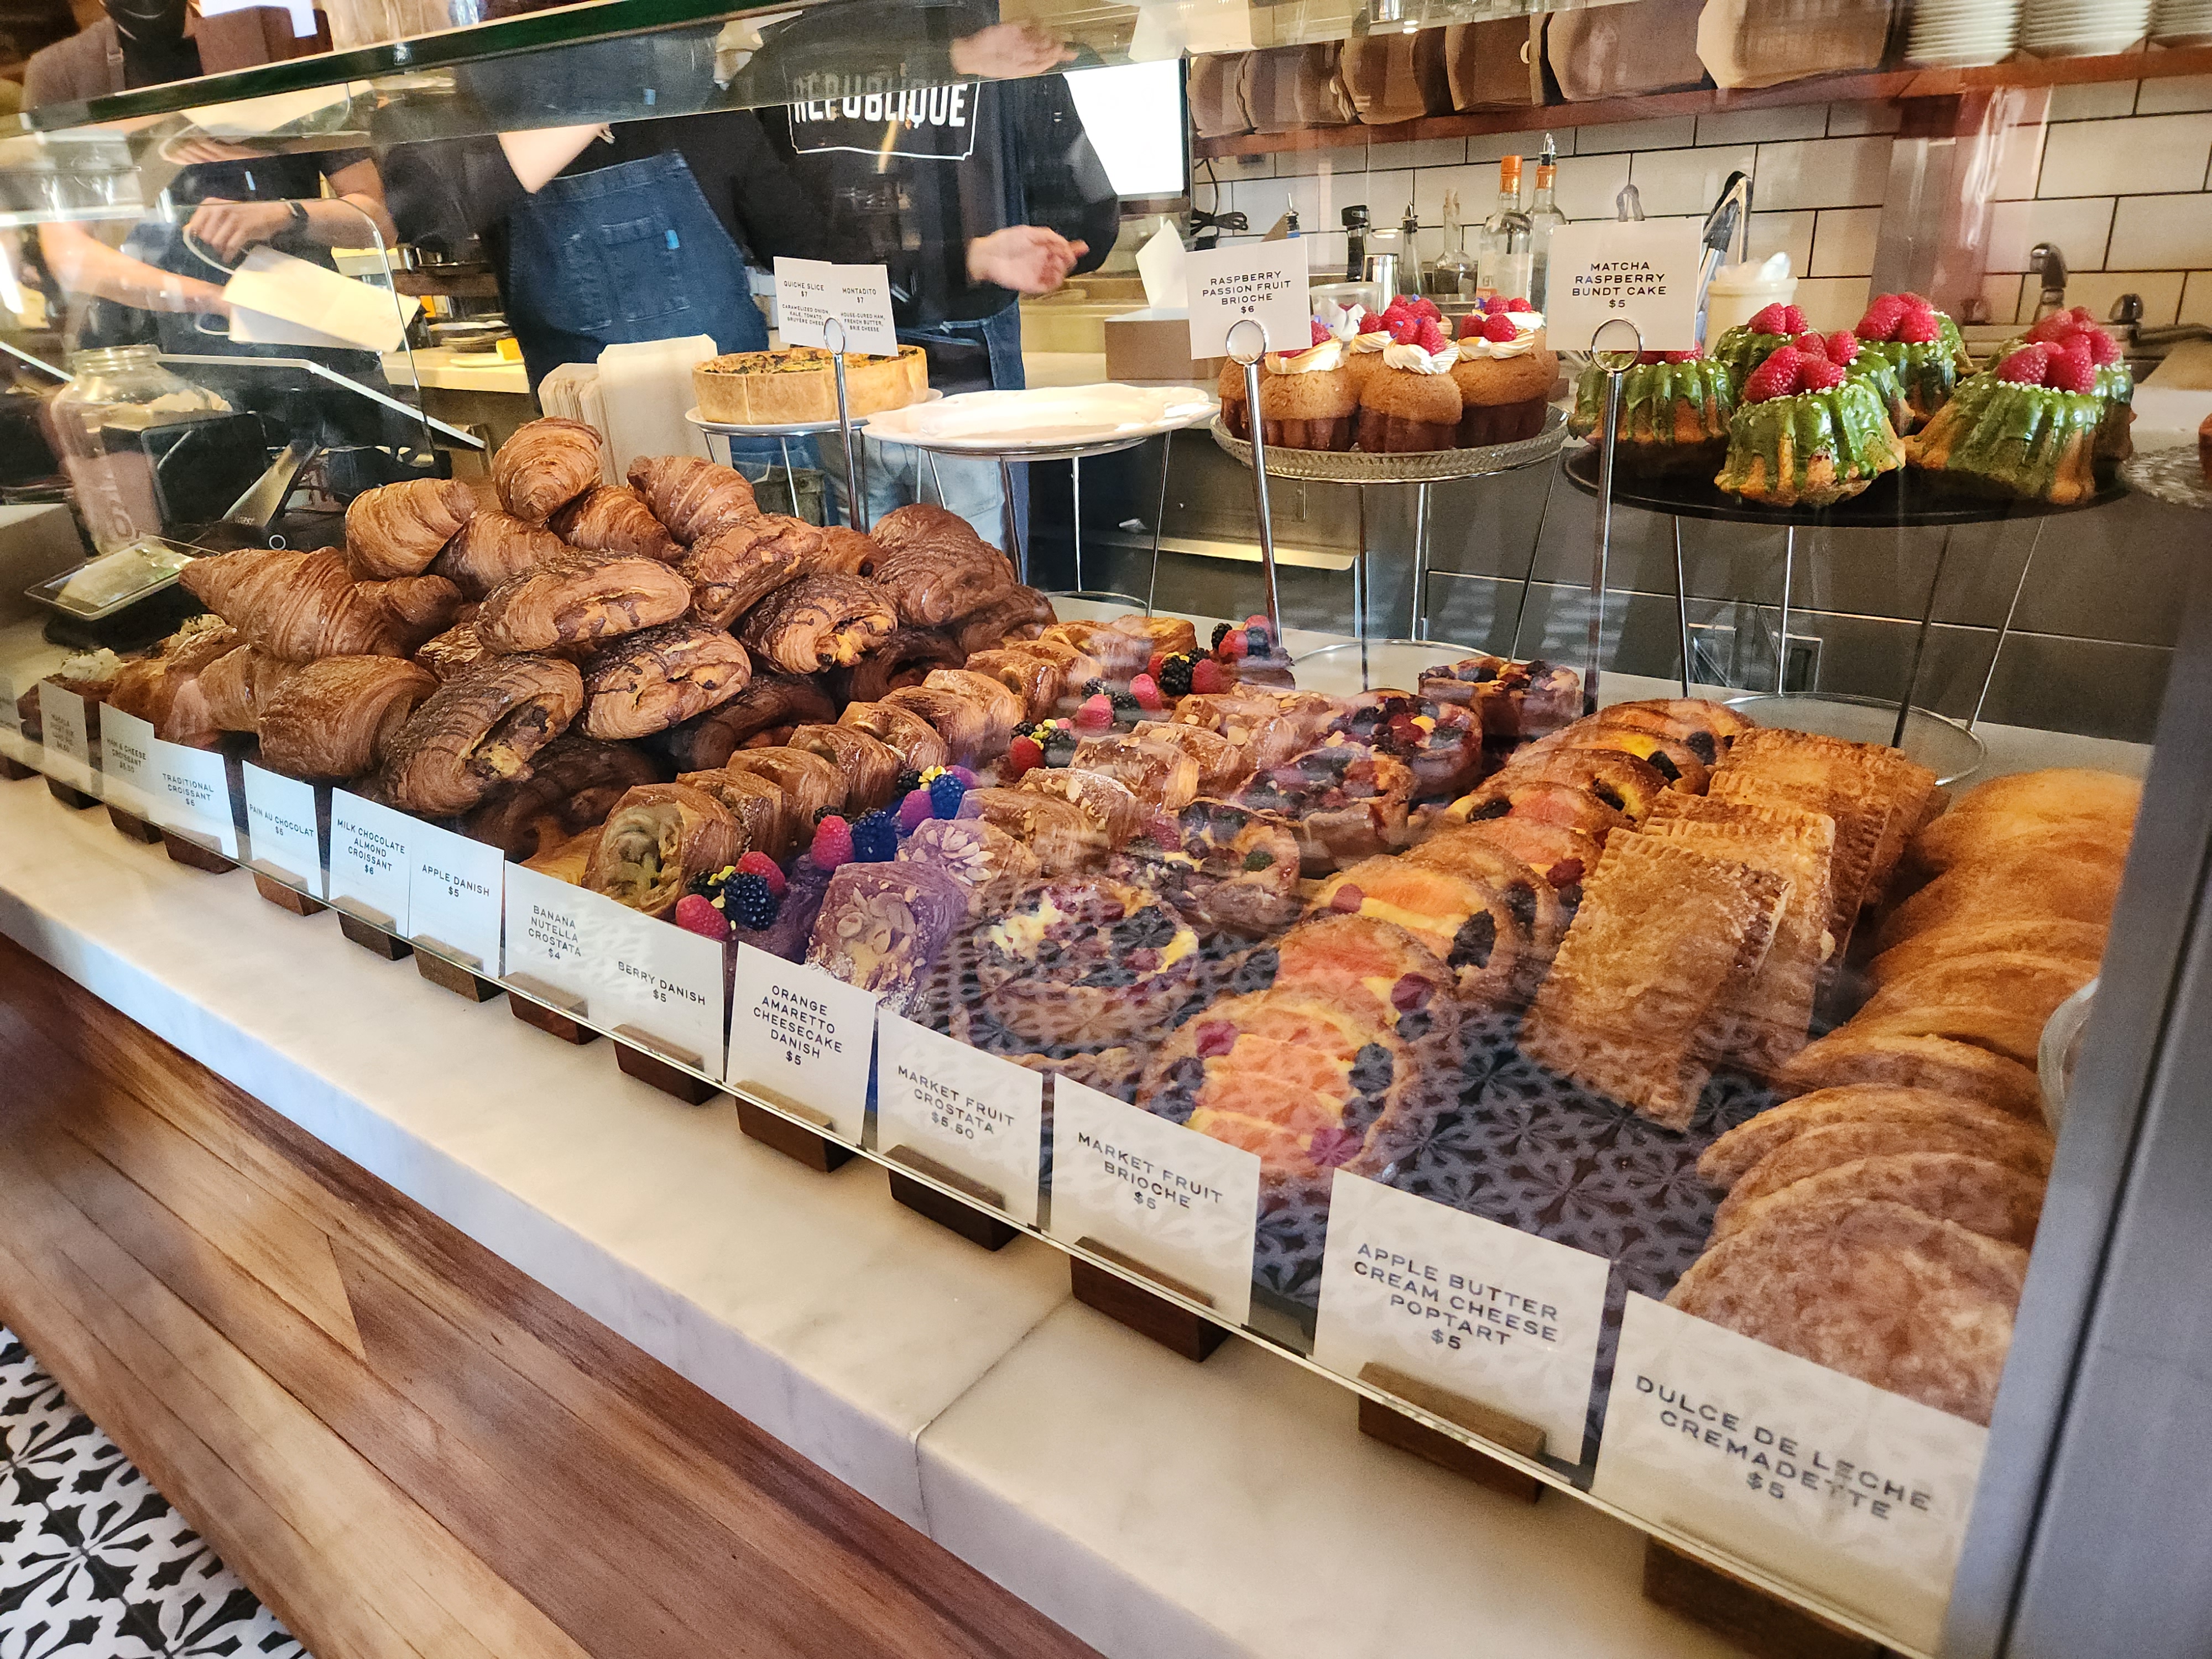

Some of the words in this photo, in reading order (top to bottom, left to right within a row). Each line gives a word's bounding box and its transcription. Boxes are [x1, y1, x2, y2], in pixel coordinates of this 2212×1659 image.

[1210, 270, 1282, 286] RASPBERRY
[1575, 273, 1665, 284] RASPBERRY
[1590, 261, 1650, 271] MATCHA
[784, 280, 805, 289] QUICHE
[807, 281, 825, 291] SLICE
[1202, 285, 1253, 297] PASSION
[1257, 280, 1291, 291] FRUIT
[1572, 287, 1621, 296] BUNDT
[1627, 286, 1667, 295] CAKE
[1221, 293, 1272, 305] BRIOCHE
[1240, 306, 1255, 314] $6
[1609, 299, 1626, 308] $5
[163, 773, 214, 792] TRADITIONAL
[168, 784, 211, 801] CROISSANT
[249, 804, 263, 816] PAIN
[264, 812, 273, 821] AU
[274, 816, 314, 837] CHOCOLAT
[337, 818, 356, 833] MILK
[358, 827, 405, 854] CHOCOLATE
[354, 838, 387, 858] ALMOND
[348, 846, 392, 872] CROISSANT
[364, 864, 374, 875] $6
[422, 864, 450, 882] APPLE
[453, 875, 489, 897] DANISH
[448, 886, 459, 898] $5
[531, 916, 578, 943] NUTELLA
[533, 905, 576, 930] BANANA
[528, 928, 581, 957] CROSTATA
[547, 948, 561, 960] $4
[618, 961, 655, 985] BERRY
[660, 979, 706, 1005] DANISH
[652, 989, 666, 1003] $5
[772, 985, 827, 1016] ORANGE
[762, 996, 835, 1034] AMARETTO
[753, 1006, 842, 1053] CHEESECAKE
[770, 1029, 820, 1059] DANISH
[785, 1050, 801, 1066] $5
[898, 1065, 959, 1102] MARKET
[966, 1097, 1015, 1126] FRUIT
[914, 1088, 994, 1134] CROSTATA
[1078, 1132, 1154, 1174] MARKET
[1162, 1169, 1223, 1203] FRUIT
[1104, 1160, 1191, 1209] BRIOCHE
[1134, 1191, 1156, 1210] $5
[1358, 1243, 1439, 1282] APPLE
[1449, 1274, 1558, 1321] BUTTER
[1354, 1261, 1439, 1302] CREAM
[1449, 1295, 1557, 1343] CHEESE
[1390, 1294, 1511, 1345] POPTART
[1431, 1328, 1461, 1350] $5
[1636, 1375, 1739, 1432] DULCE
[1754, 1426, 1798, 1457] DE
[1813, 1450, 1932, 1512] LECHE
[1747, 1472, 1786, 1500] $5
